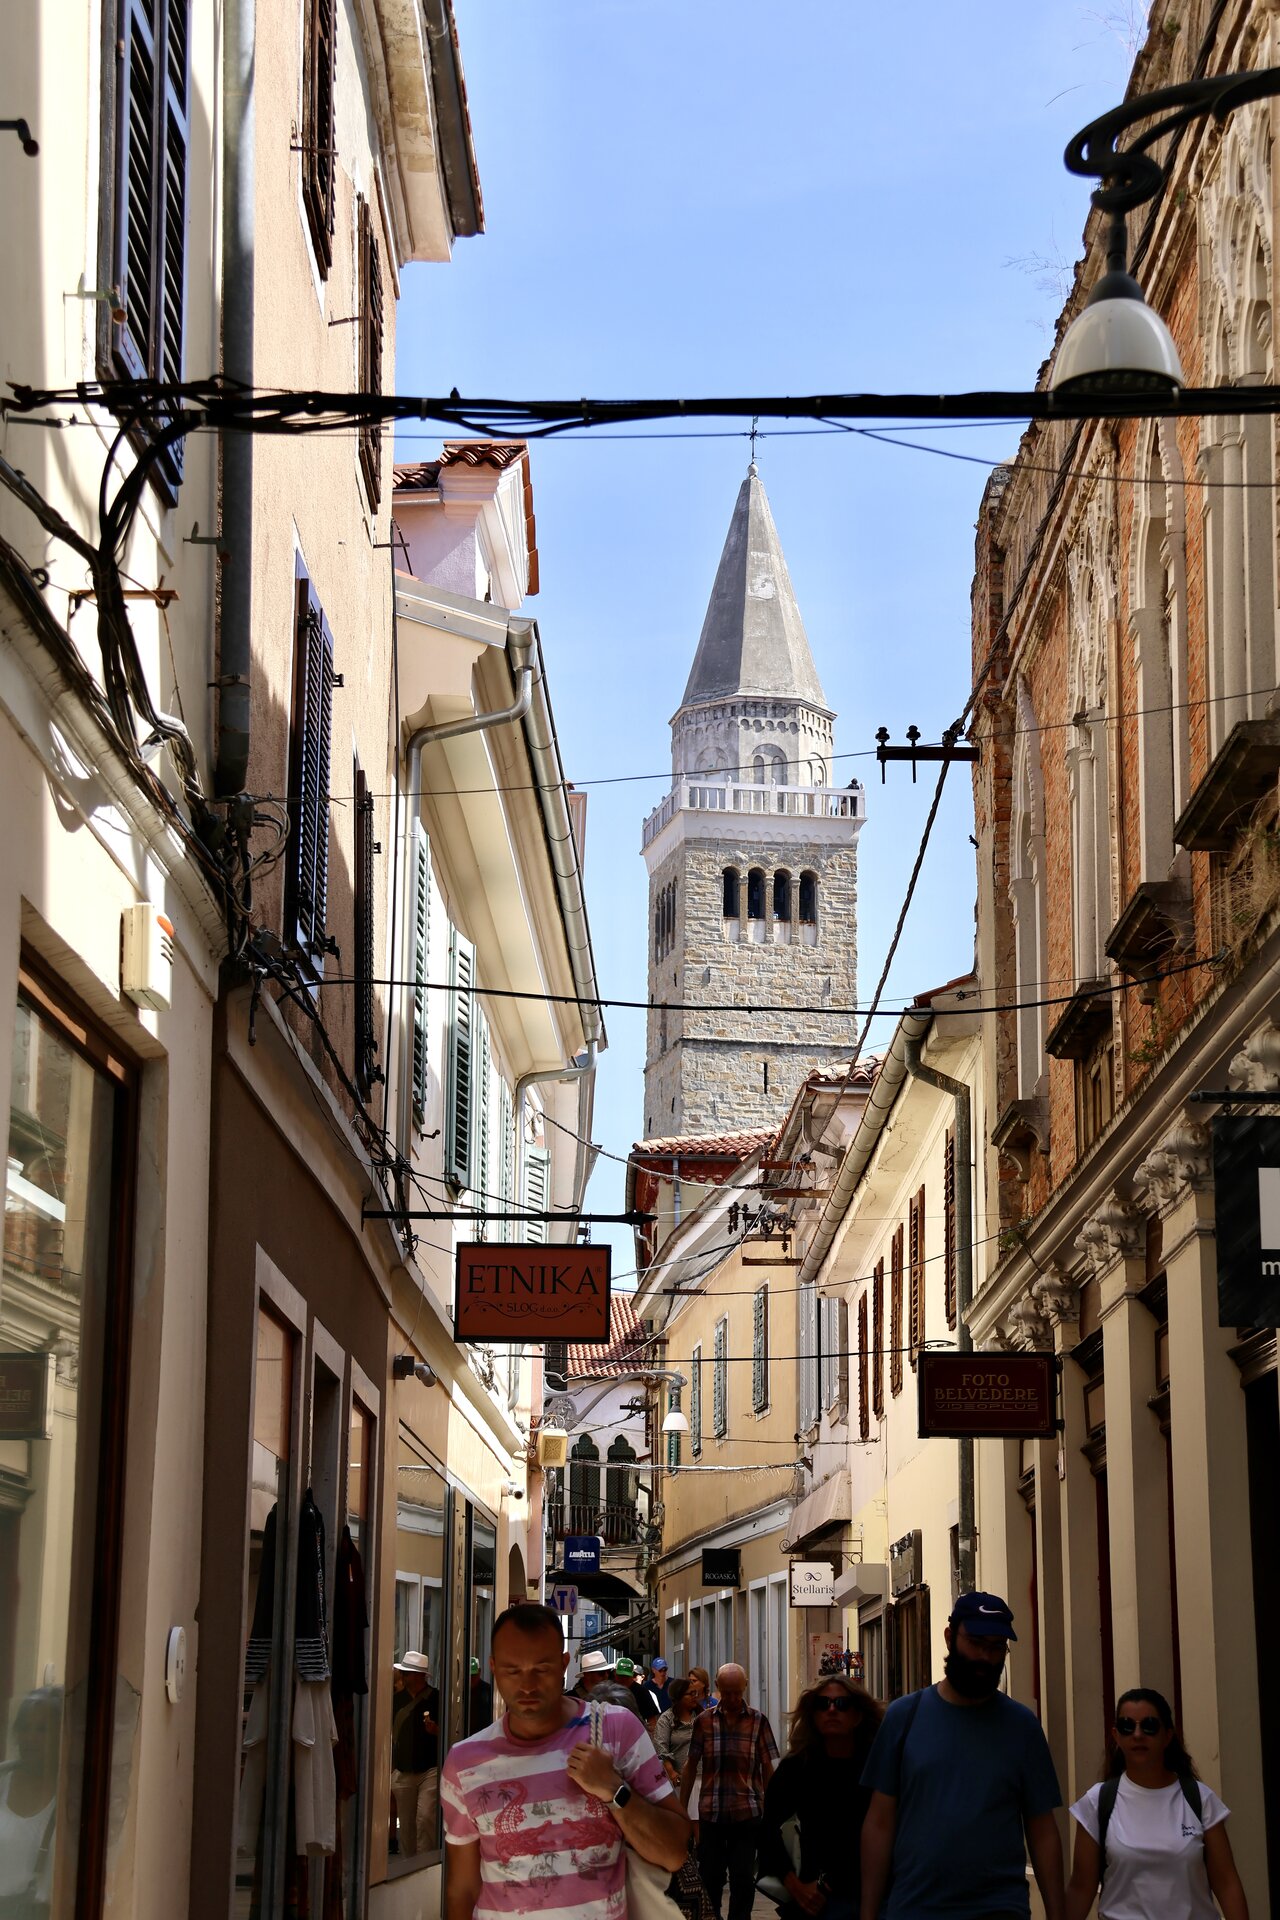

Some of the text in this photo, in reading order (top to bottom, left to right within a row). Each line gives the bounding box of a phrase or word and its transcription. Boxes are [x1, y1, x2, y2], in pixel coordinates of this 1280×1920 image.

[467, 1265, 600, 1295] ETNIKA
[507, 1302, 538, 1313] SLOG
[962, 1374, 1010, 1386] FOTO
[935, 1388, 1039, 1401] BELVEDERE
[935, 1402, 1039, 1410] VIDEOPLUS
[792, 1584, 834, 1594] Stellaris
